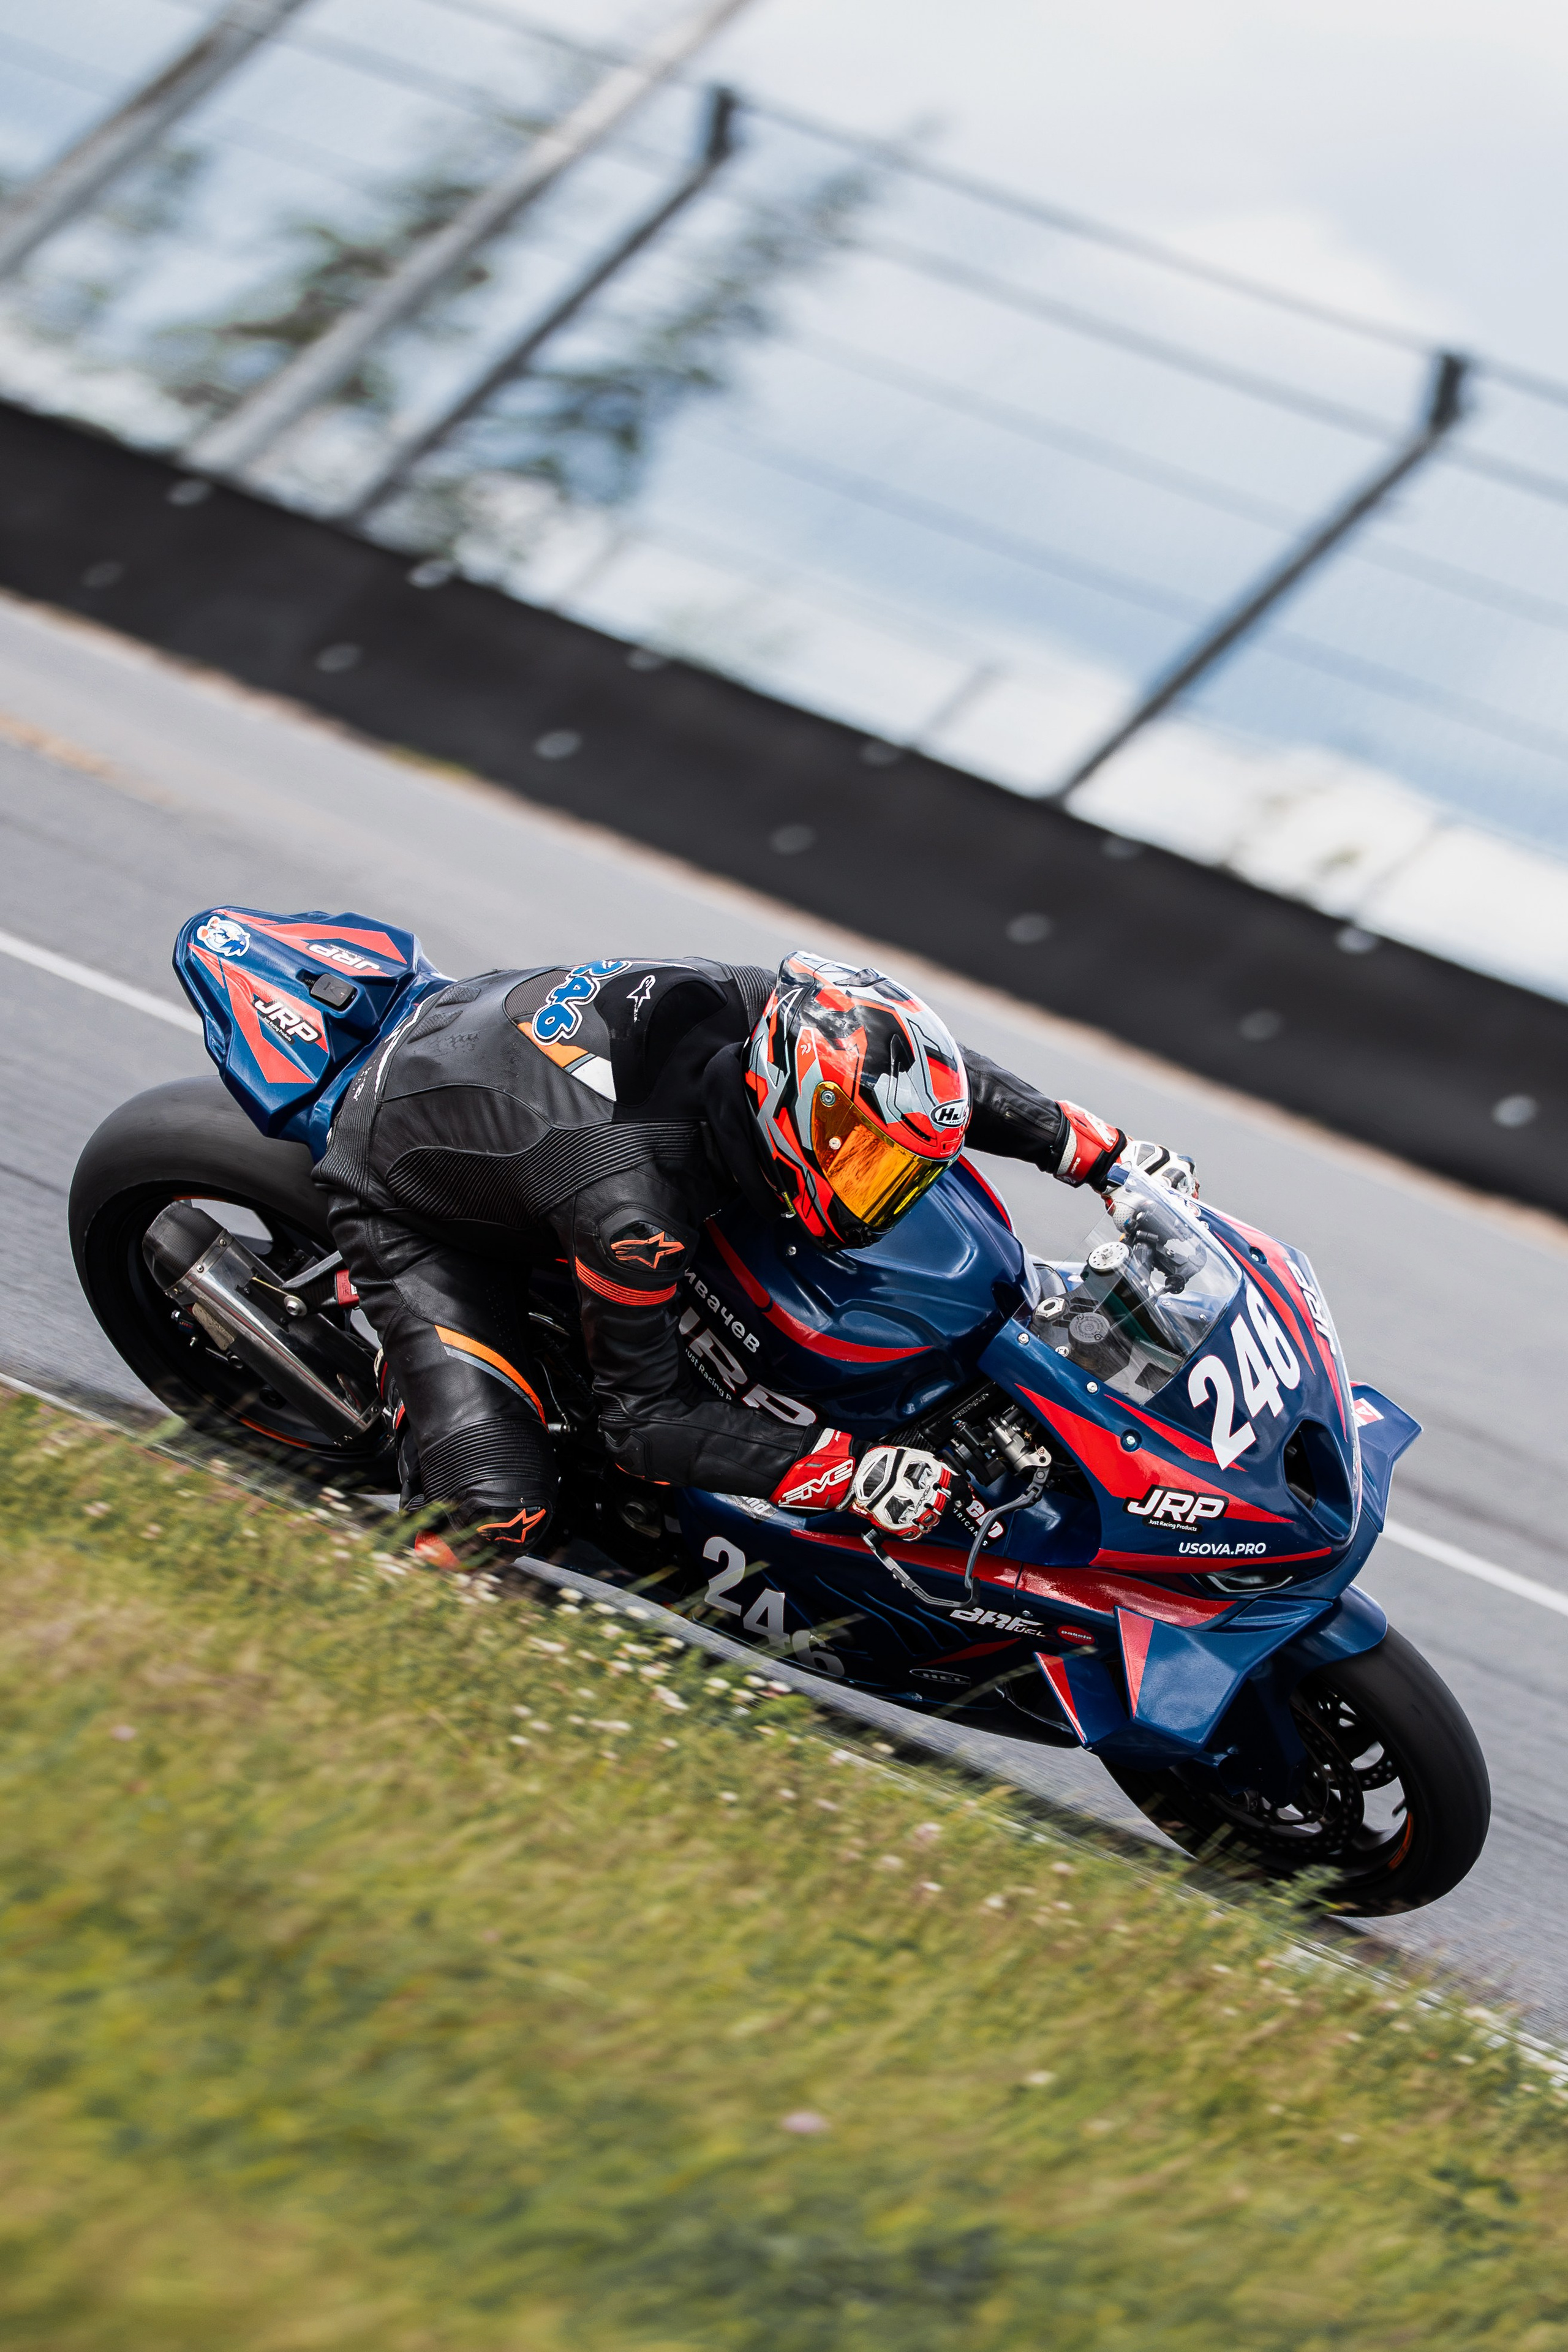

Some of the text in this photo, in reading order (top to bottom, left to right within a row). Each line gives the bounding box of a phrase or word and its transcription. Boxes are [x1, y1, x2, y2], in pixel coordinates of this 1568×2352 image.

[254, 1000, 318, 1041] JRP
[698, 1363, 725, 1397] Racing
[1188, 1283, 1300, 1471] 246
[1127, 1489, 1225, 1523] JRP
[1159, 1521, 1176, 1529] Racing
[1176, 1523, 1197, 1532] Products
[1178, 1542, 1267, 1555] USOVA.PRO
[703, 1536, 845, 1676] 246
